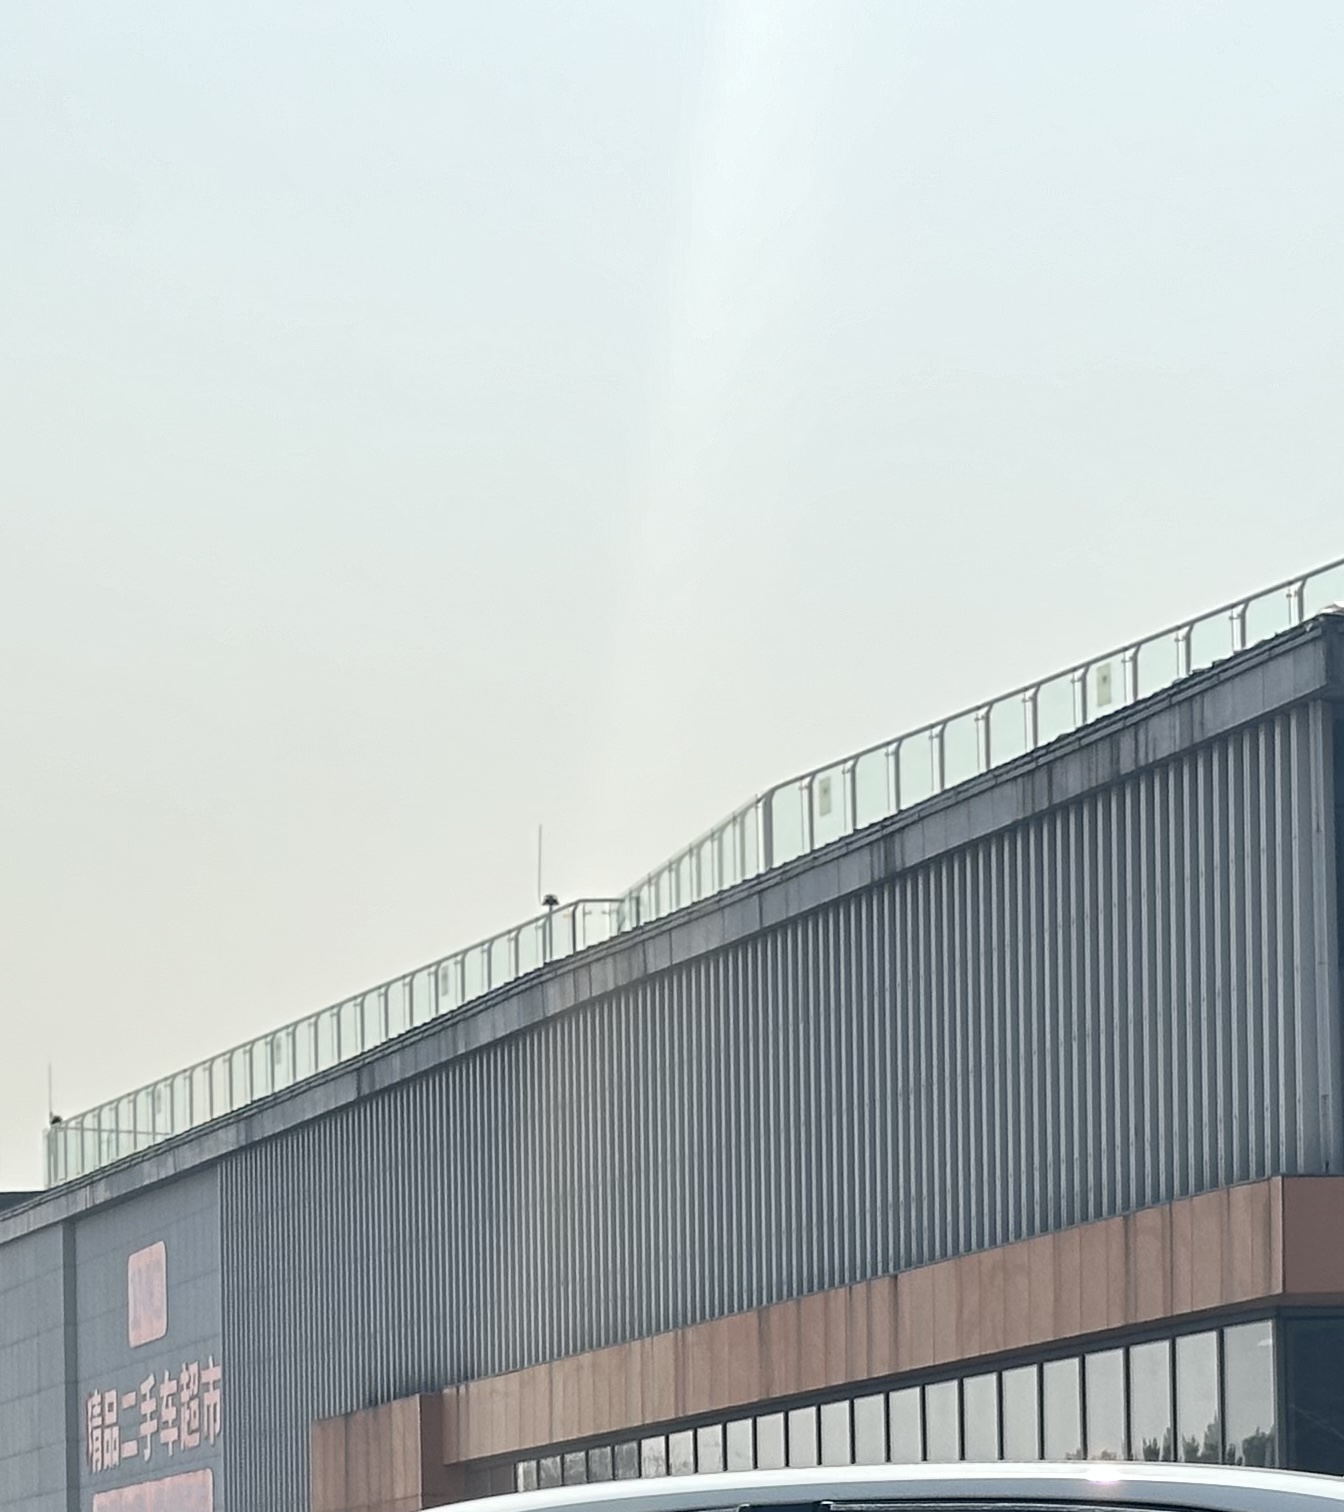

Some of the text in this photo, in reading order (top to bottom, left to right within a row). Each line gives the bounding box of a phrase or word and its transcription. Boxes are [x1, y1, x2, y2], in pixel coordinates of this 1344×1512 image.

[86, 1355, 222, 1473] 精品二手车超市
